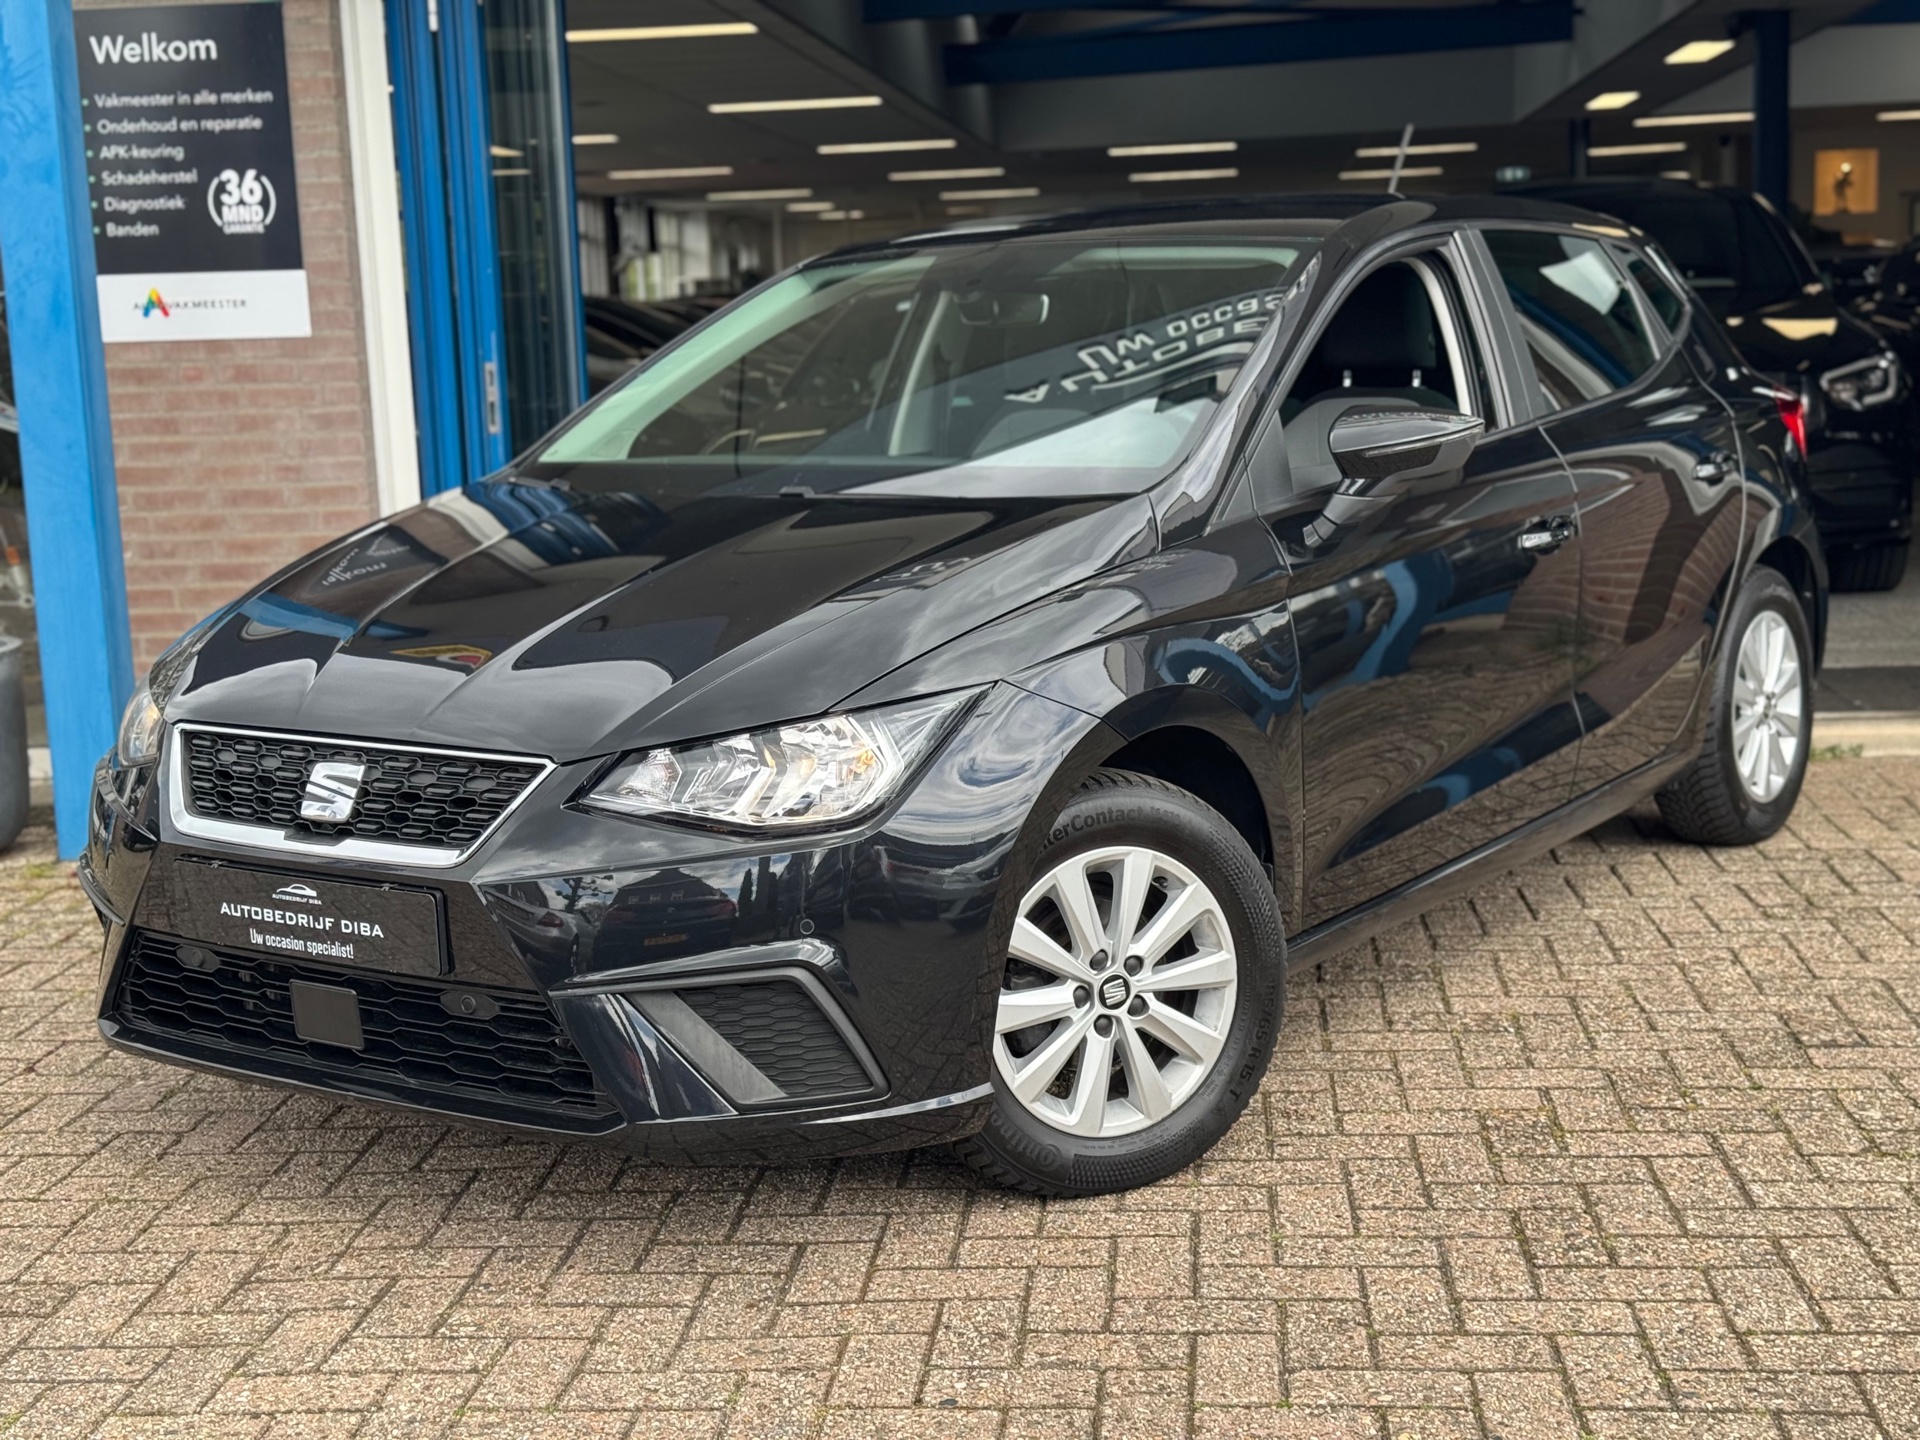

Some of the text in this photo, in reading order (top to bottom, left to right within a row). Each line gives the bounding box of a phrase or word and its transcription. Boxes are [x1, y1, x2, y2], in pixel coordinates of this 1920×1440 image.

[89, 32, 218, 65] Welkom
[94, 88, 274, 108] Vakmeester in alle merken
[97, 115, 263, 134] Onderhoud en reparatie
[99, 144, 185, 162] APK-keuring
[101, 168, 198, 186] Schadeherstel
[219, 168, 263, 205] 36
[104, 195, 185, 214] Diagnostiek
[221, 204, 264, 223] MND
[106, 221, 160, 238] Banden
[220, 902, 384, 938] AUTOBEDRIJF DIBA
[249, 927, 354, 959] Uw occasion specialist!
